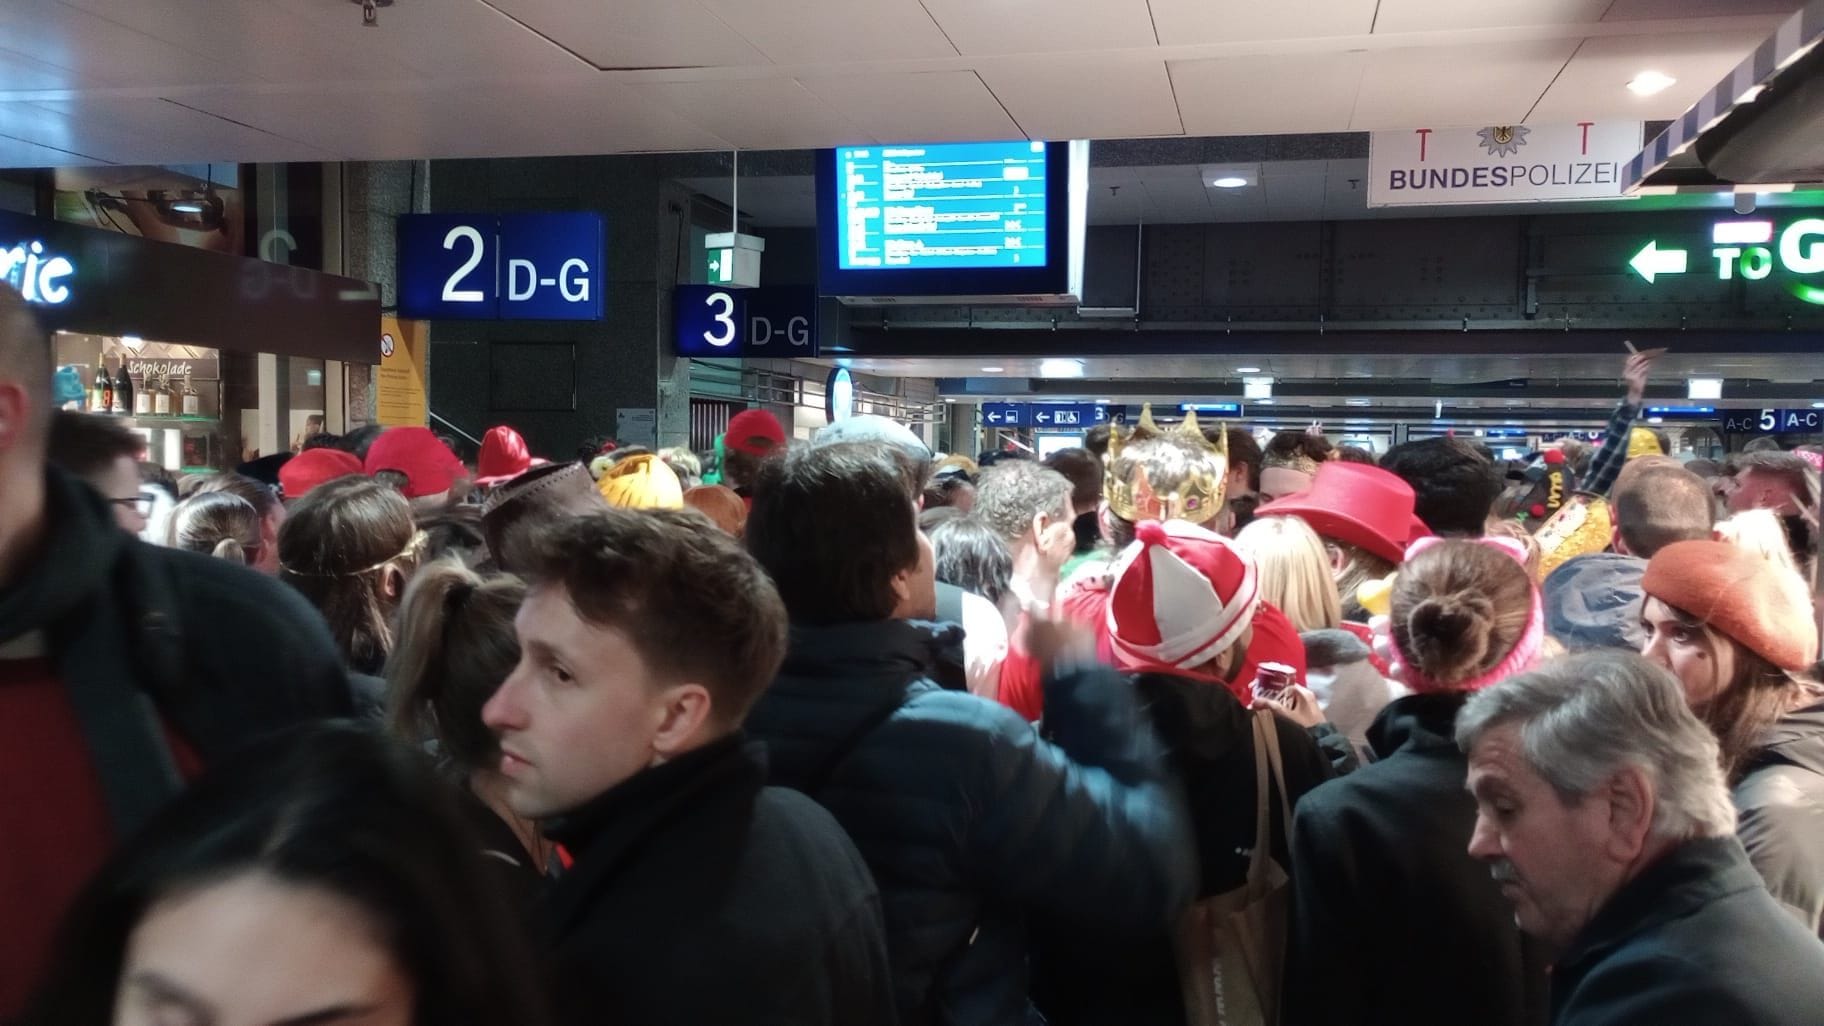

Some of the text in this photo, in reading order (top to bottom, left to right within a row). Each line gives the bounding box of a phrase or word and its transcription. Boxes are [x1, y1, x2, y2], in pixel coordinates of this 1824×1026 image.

[1389, 162, 1618, 190] BUNDESPOLIZEI
[442, 225, 590, 303] 2 D-G
[1712, 247, 1772, 280] TO
[703, 292, 809, 347] 3 D-G
[127, 360, 192, 375] Schokolade
[1726, 409, 1818, 431] A-C 5 A-C
